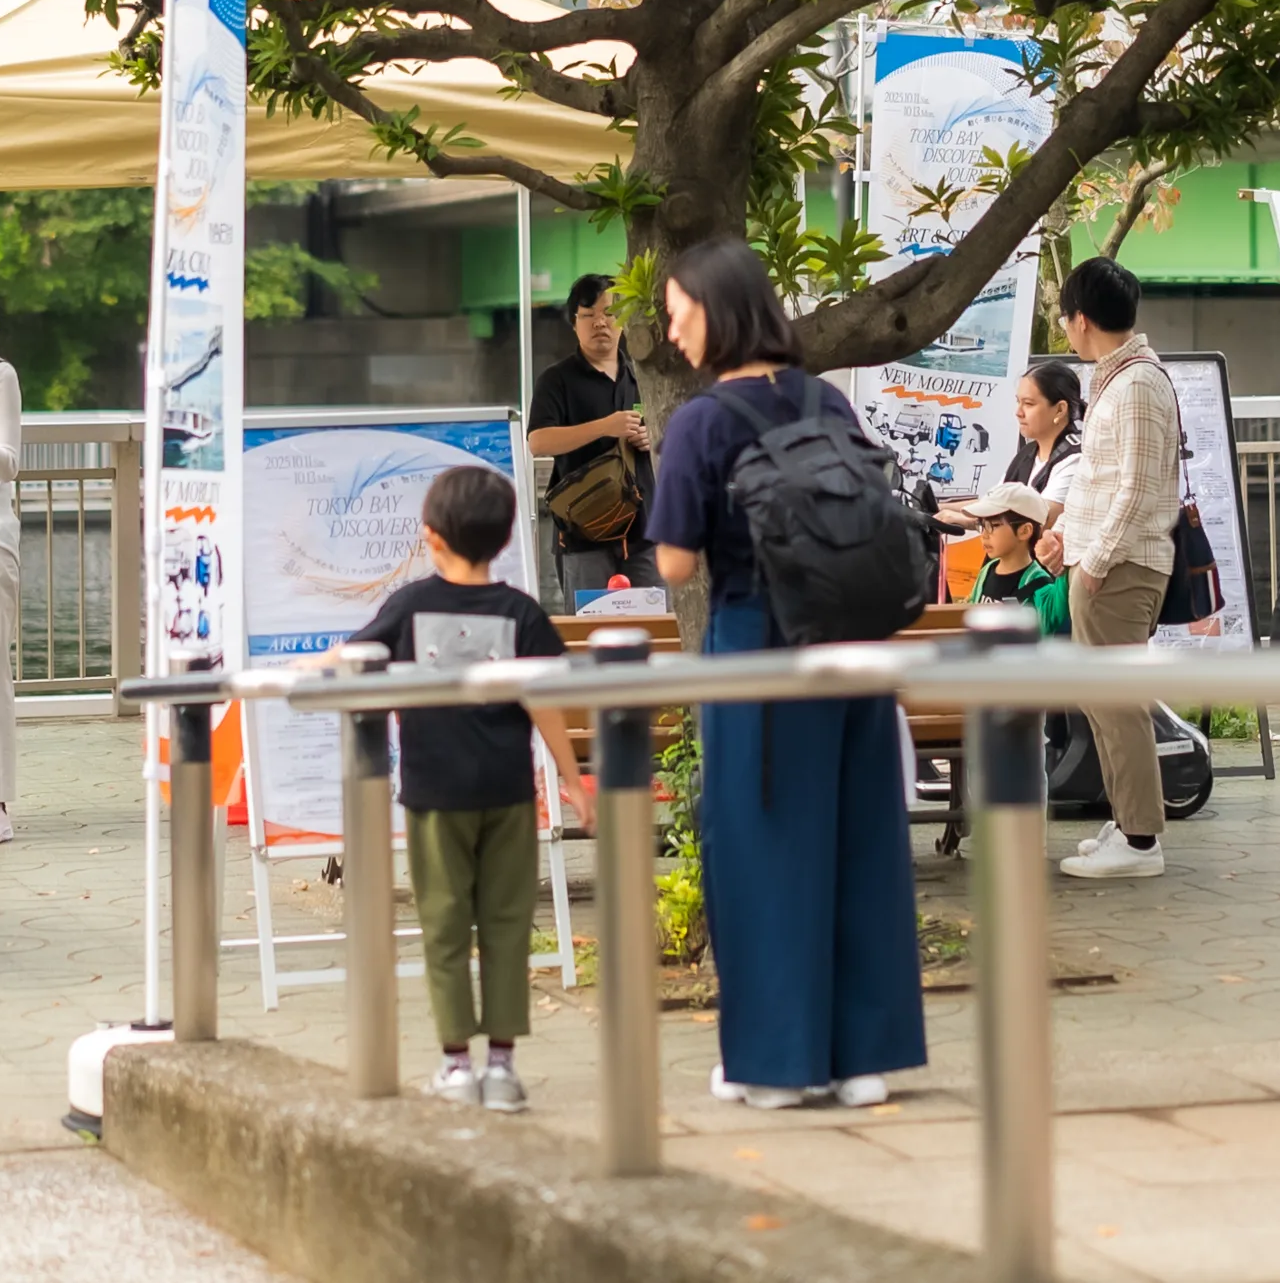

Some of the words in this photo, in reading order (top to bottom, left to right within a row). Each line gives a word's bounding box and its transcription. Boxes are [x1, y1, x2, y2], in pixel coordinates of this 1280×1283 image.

[910, 128, 953, 145] TOKYO
[956, 130, 984, 146] BAY
[923, 147, 986, 164] DISCOVER
[899, 227, 931, 243] ART
[879, 366, 919, 388] NEW
[917, 374, 999, 398] MOBILITY
[307, 496, 364, 516] TOKYO
[370, 494, 404, 514] BAY
[330, 517, 424, 538] DISCOVERY
[360, 539, 427, 560] JOURNE
[268, 636, 300, 652] ART
[302, 635, 314, 650] &
